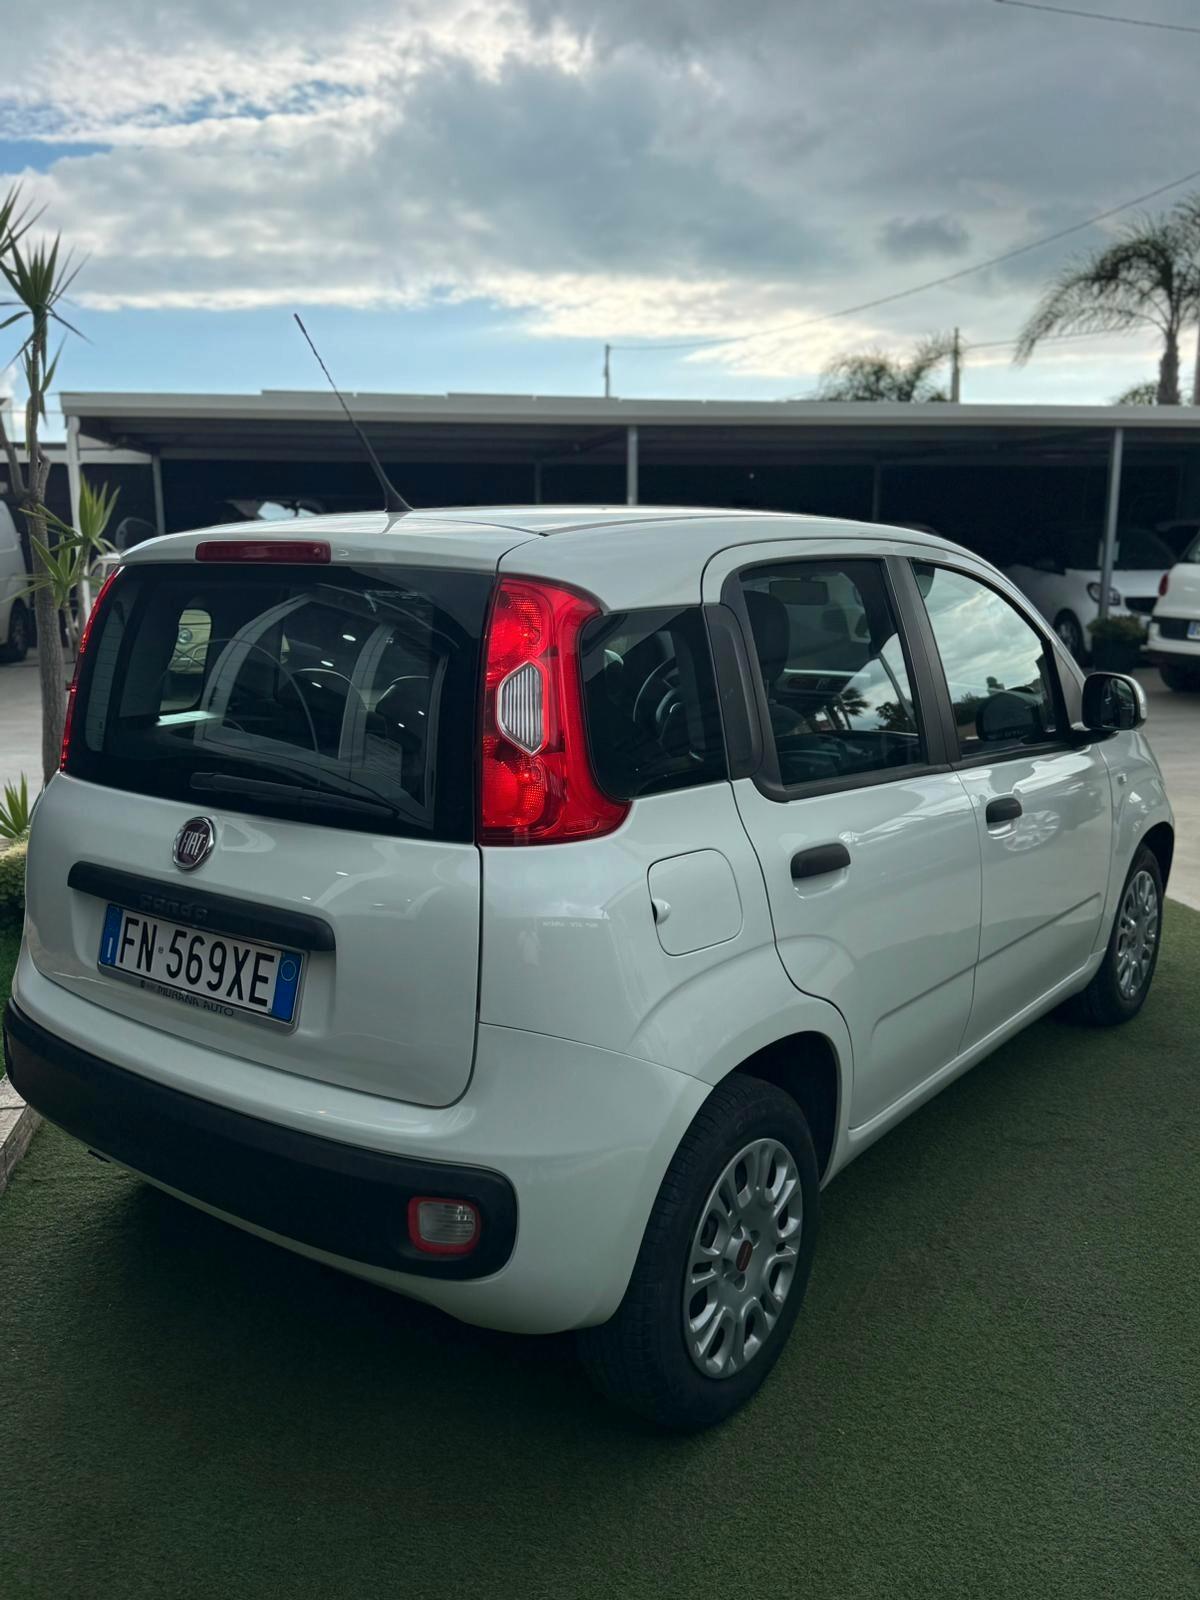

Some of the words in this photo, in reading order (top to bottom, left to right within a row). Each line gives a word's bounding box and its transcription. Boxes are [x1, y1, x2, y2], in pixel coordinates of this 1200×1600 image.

[179, 830, 207, 856] FIAT
[118, 916, 158, 973] FN
[166, 929, 275, 1008] 569XE
[203, 1000, 234, 1017] AUTO
